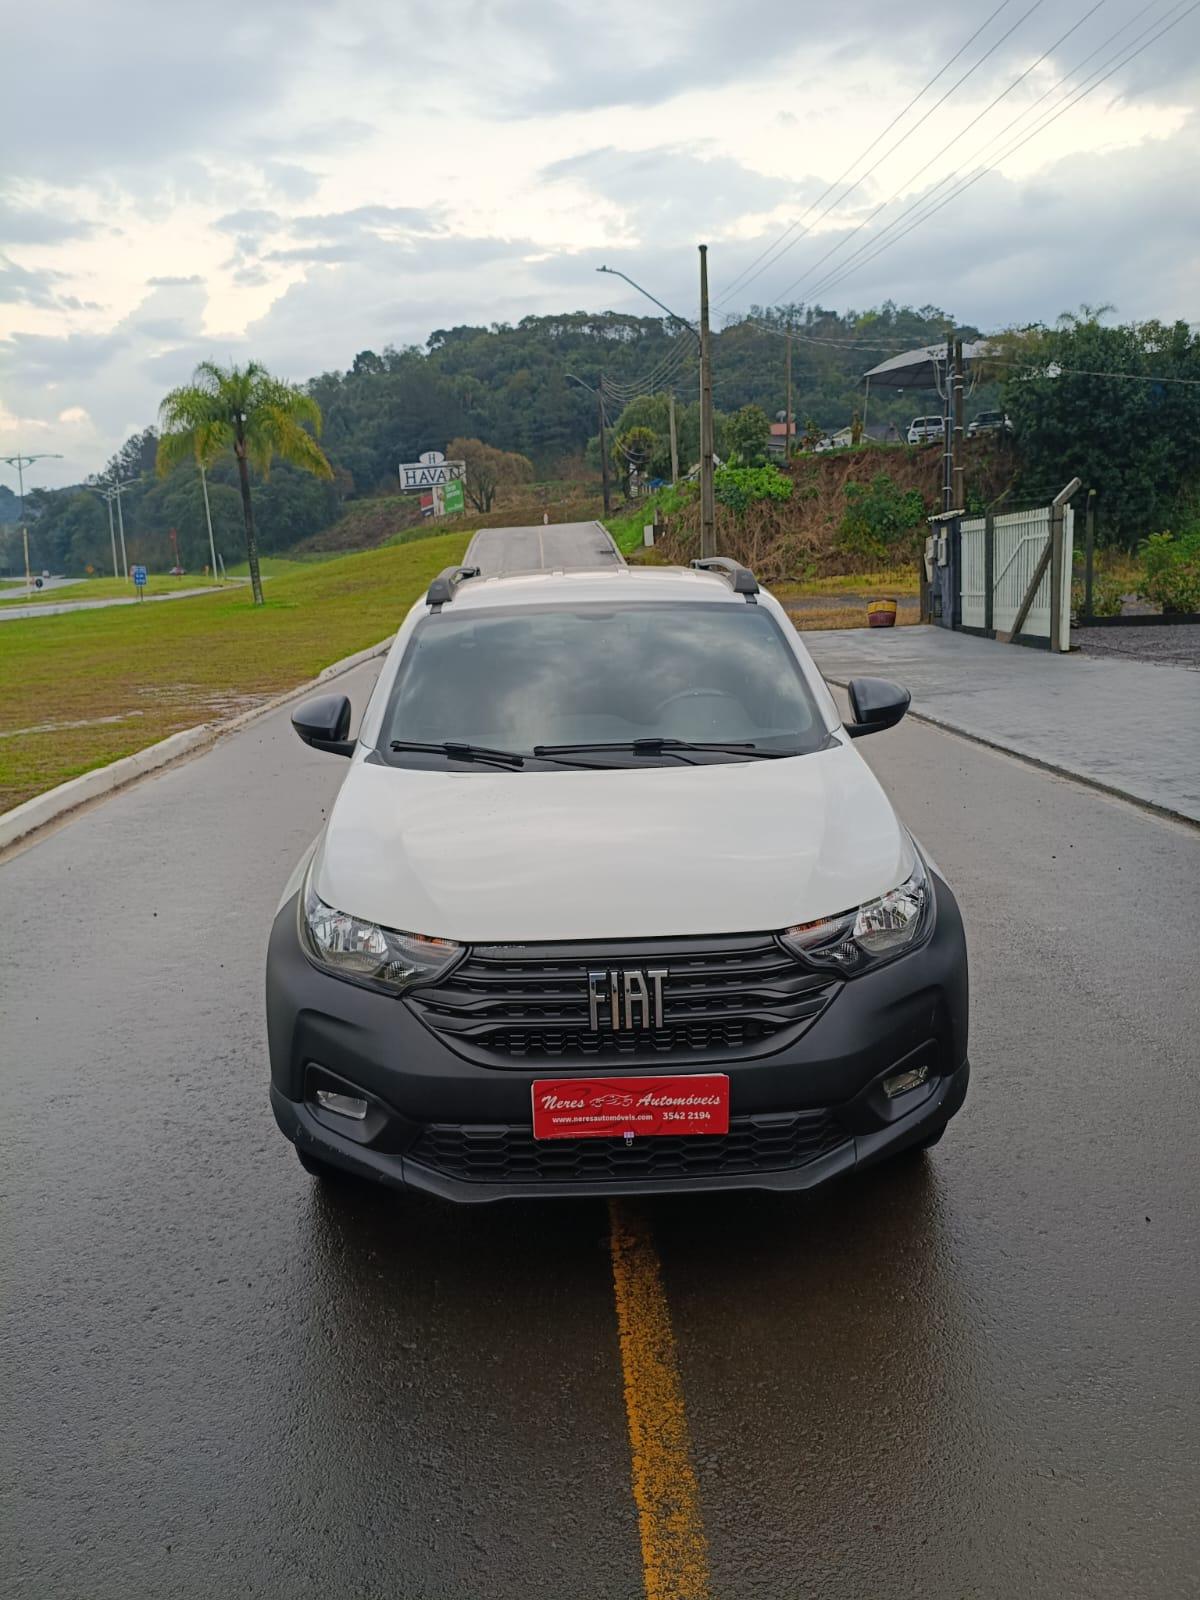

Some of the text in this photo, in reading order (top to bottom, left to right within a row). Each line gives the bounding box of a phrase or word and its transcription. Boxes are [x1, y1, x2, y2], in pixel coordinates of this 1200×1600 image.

[405, 468, 462, 484] HAVAN
[589, 970, 668, 1030] FIAT
[541, 1093, 720, 1110] Neres Automóveis
[662, 1111, 686, 1120] 3542
[687, 1112, 711, 1120] 2194
